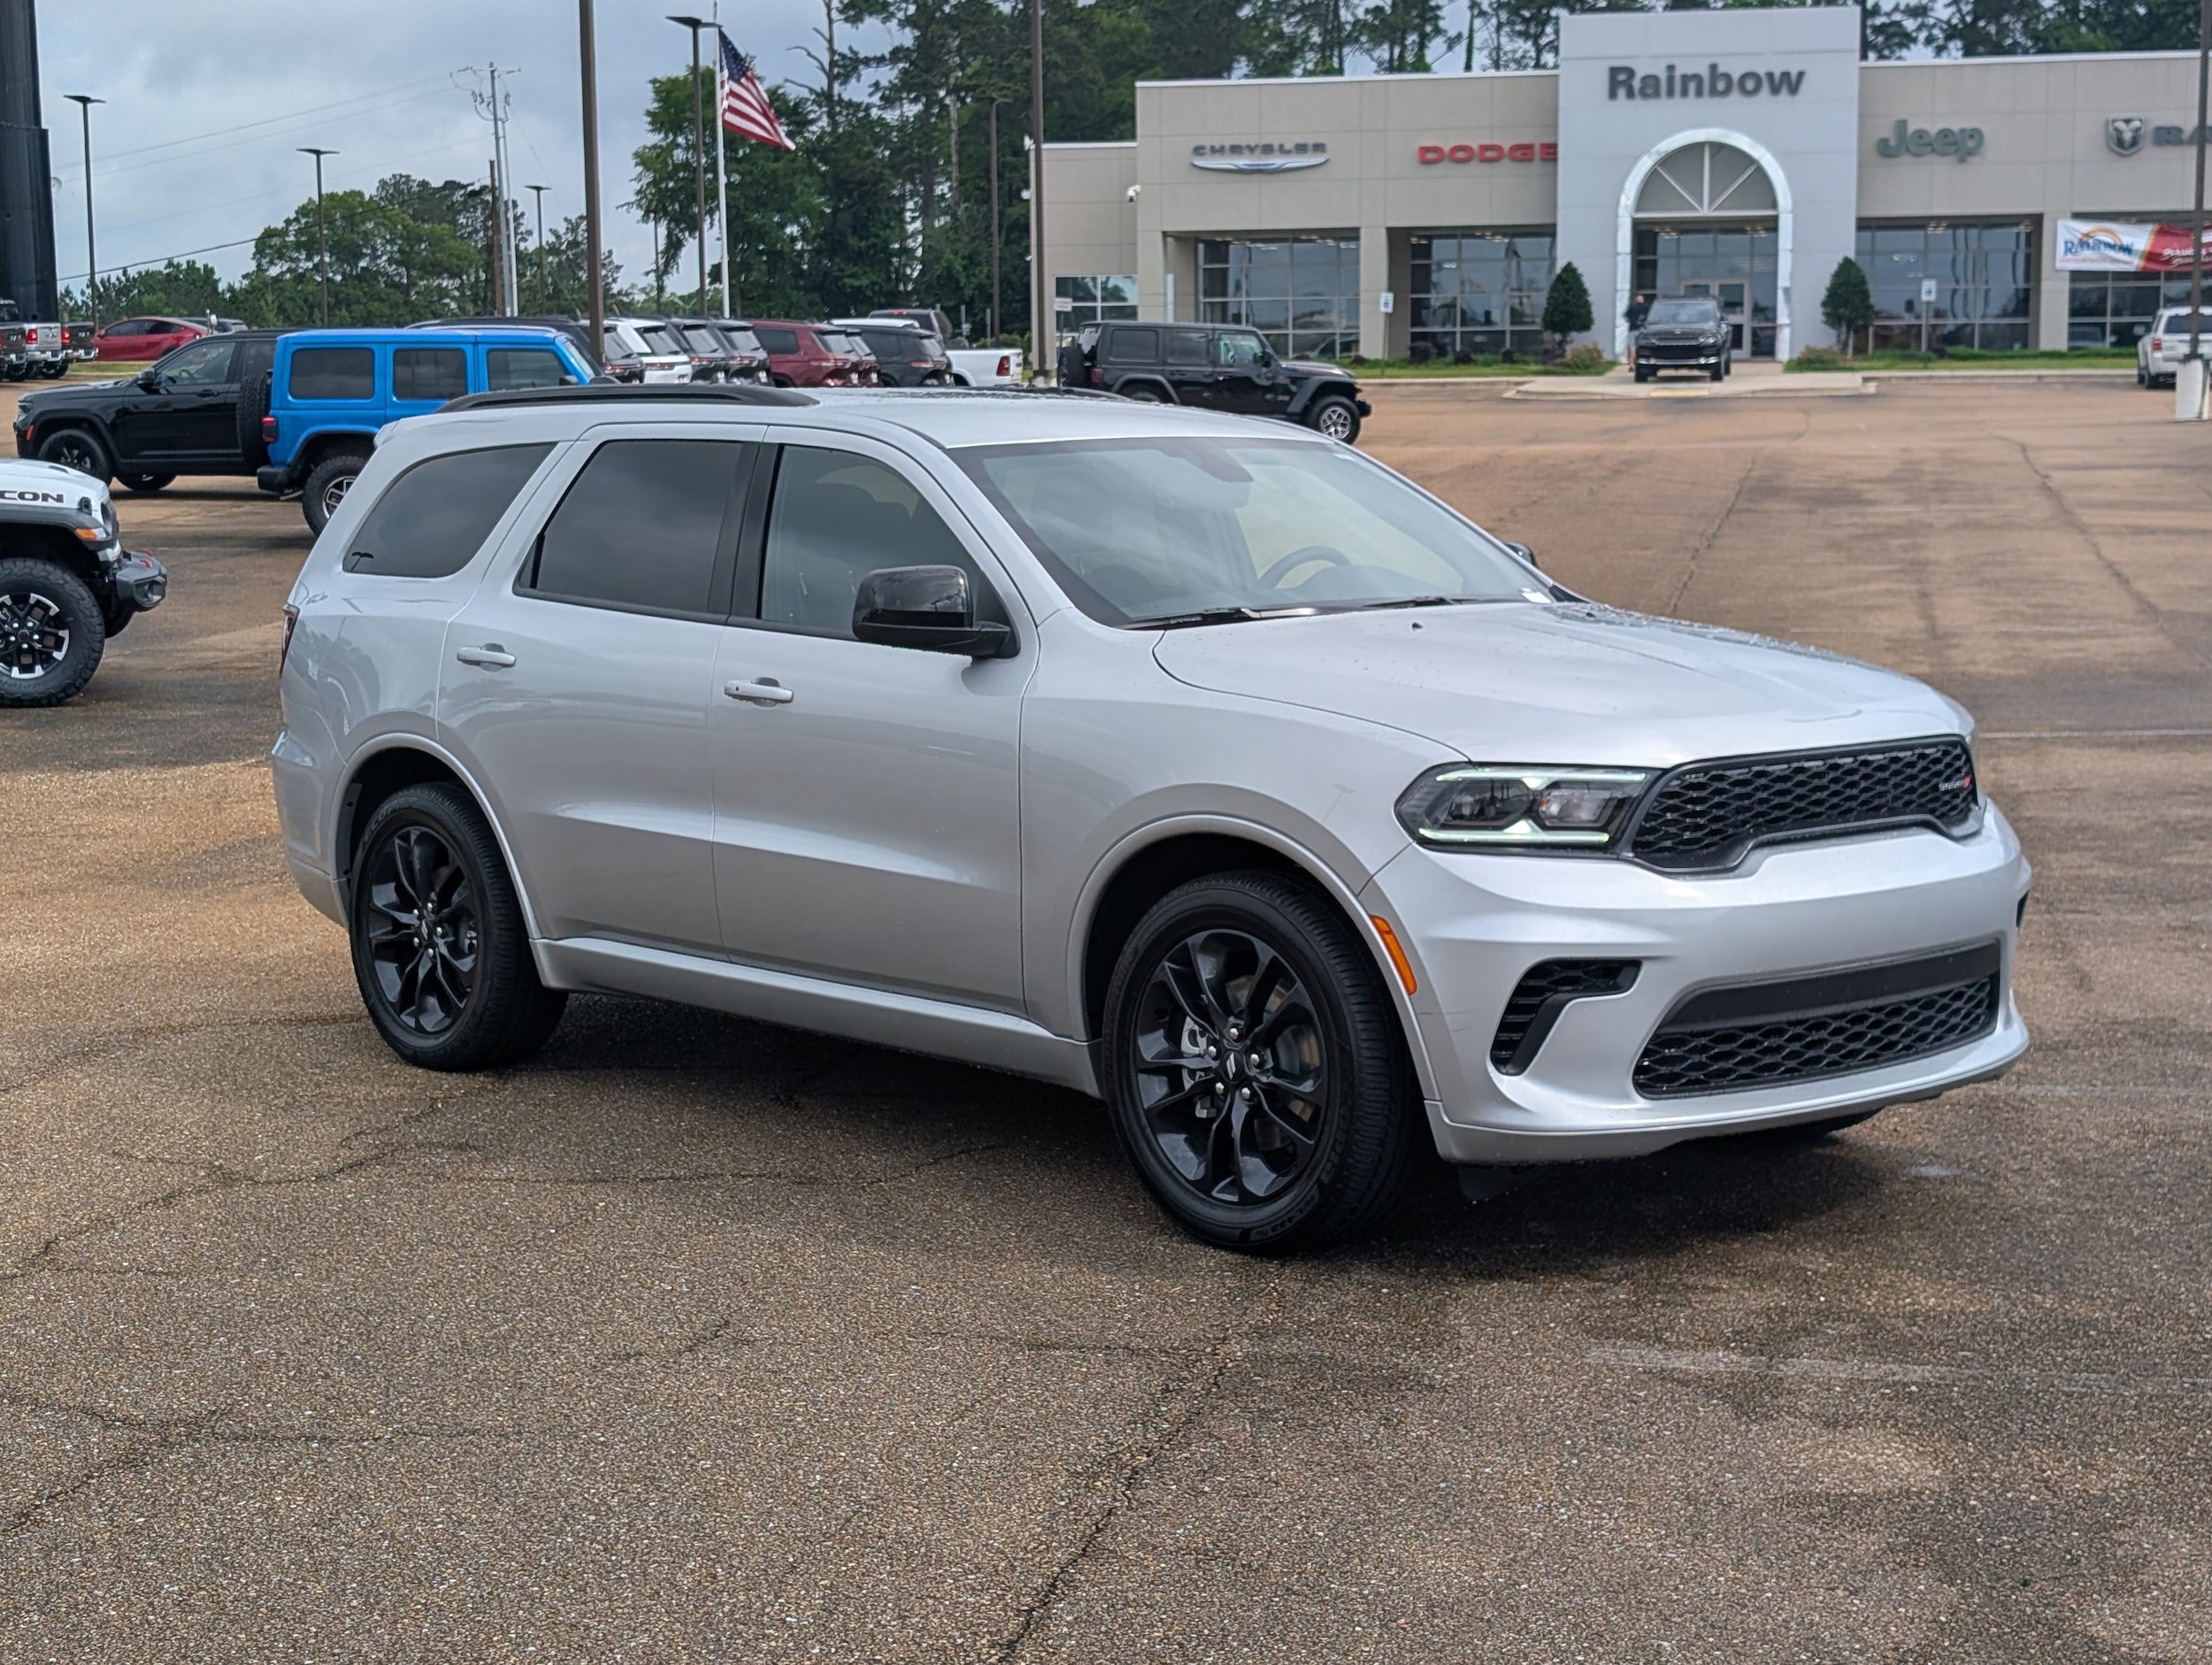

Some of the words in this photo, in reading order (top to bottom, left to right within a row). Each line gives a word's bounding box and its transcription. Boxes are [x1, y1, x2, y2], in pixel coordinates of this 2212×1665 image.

[1608, 63, 1806, 101] Rainbow
[1193, 142, 1327, 157] CHRYSLER
[1418, 142, 1559, 165] DODGE
[1877, 119, 1985, 163] Jeep
